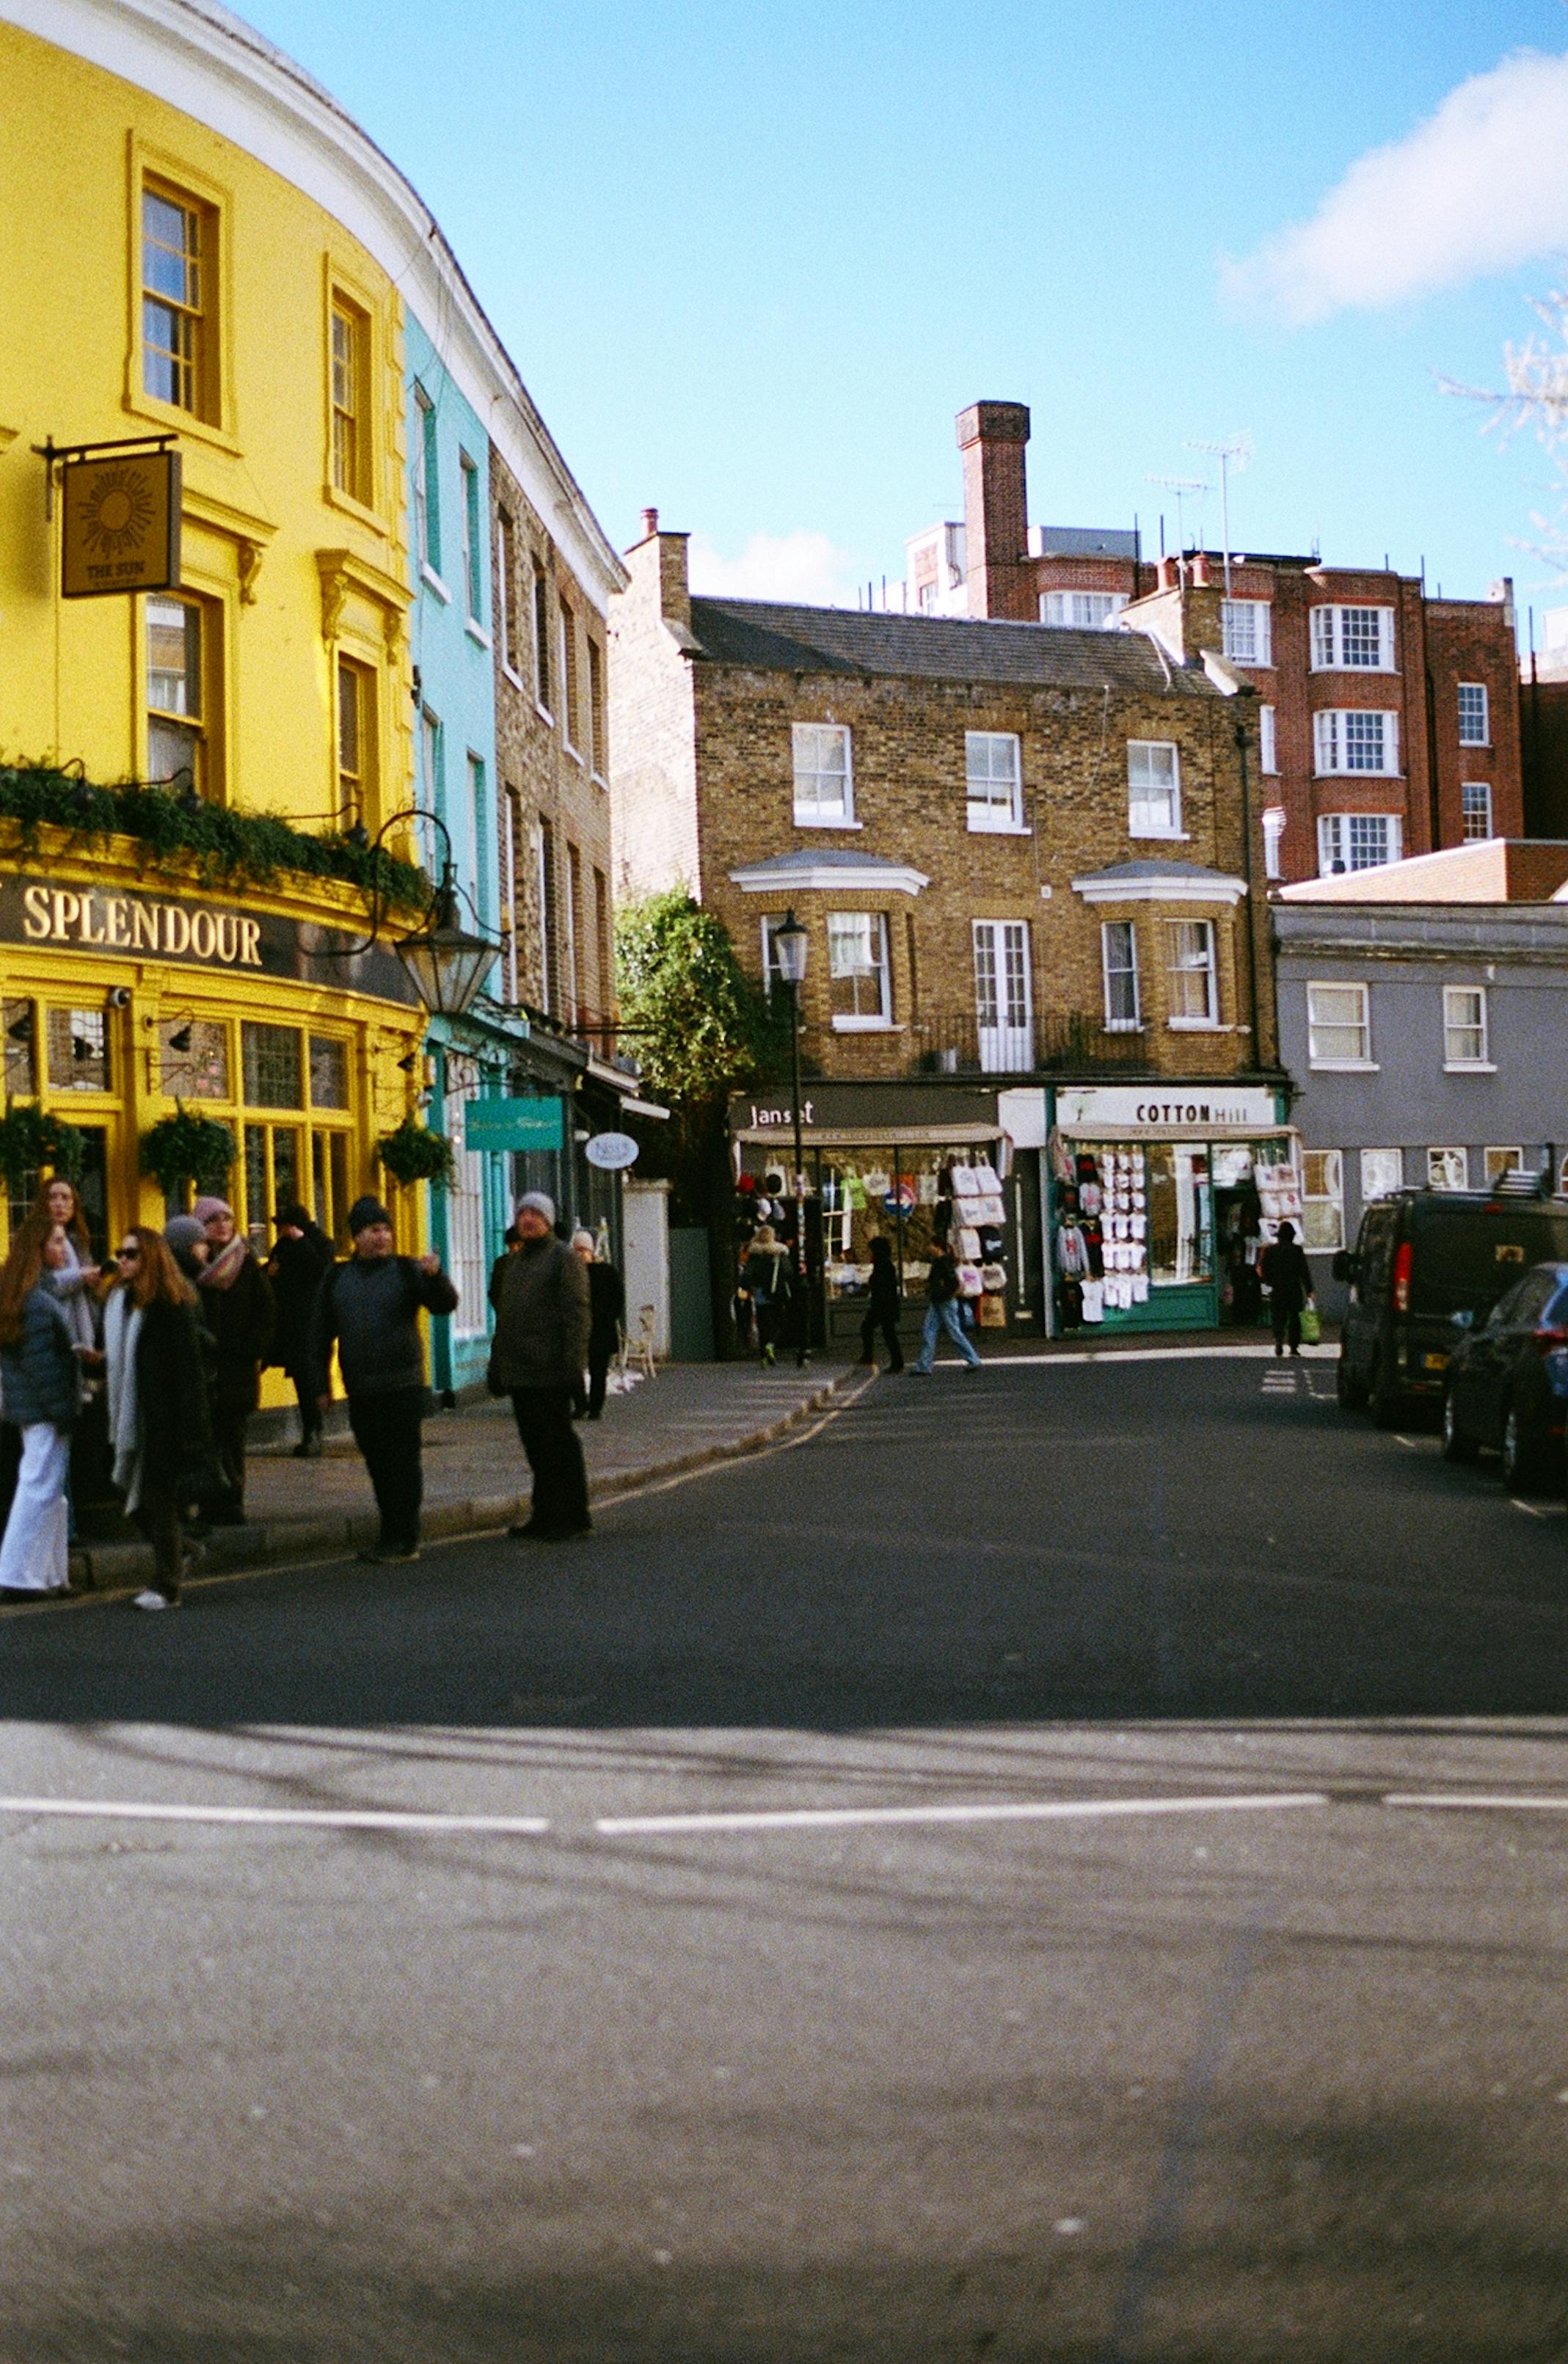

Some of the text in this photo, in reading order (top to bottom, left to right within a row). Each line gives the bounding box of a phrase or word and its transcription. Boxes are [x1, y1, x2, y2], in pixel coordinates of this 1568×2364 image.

[87, 560, 145, 579] THE SUN
[23, 885, 263, 966] SPLENDOUR
[1137, 1104, 1247, 1123] COTTON Hill
